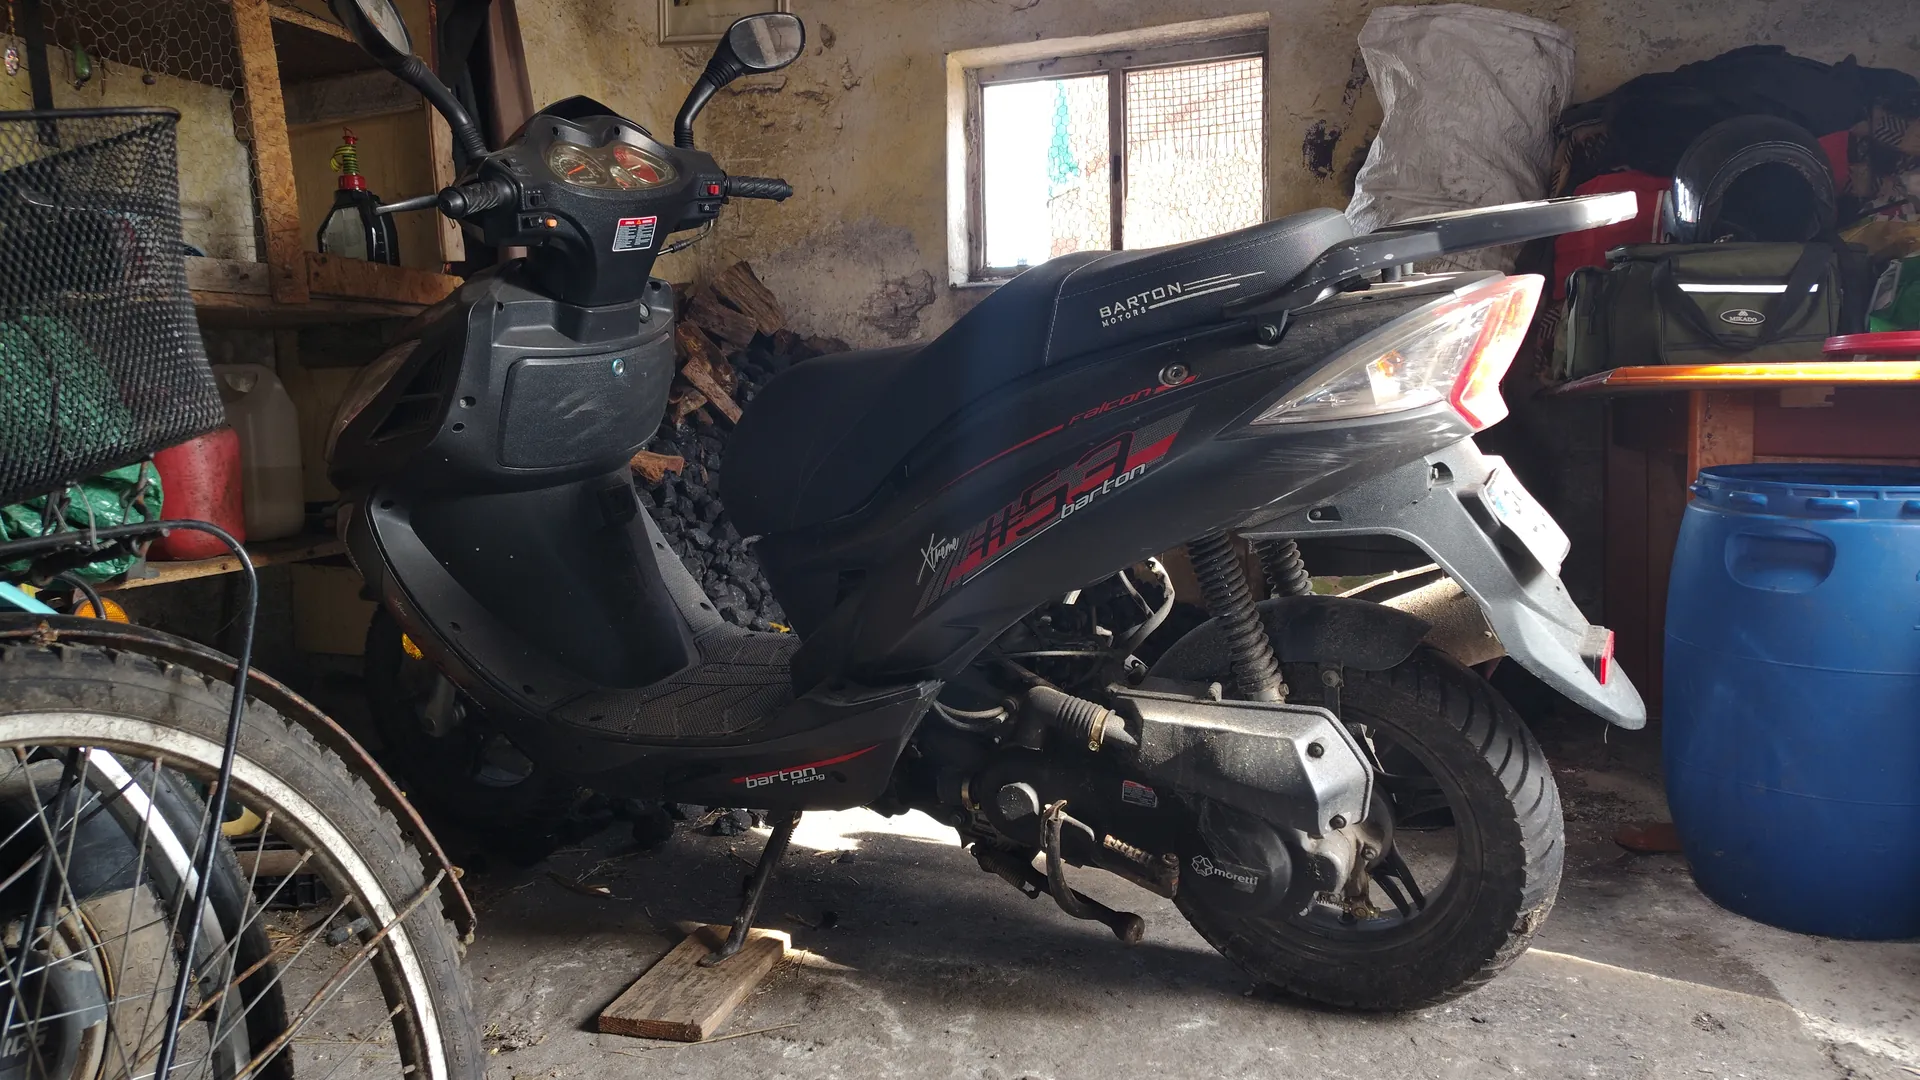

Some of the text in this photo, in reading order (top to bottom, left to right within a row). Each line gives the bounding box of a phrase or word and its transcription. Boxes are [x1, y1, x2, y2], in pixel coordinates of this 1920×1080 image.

[1099, 281, 1182, 318] BARTON
[1101, 306, 1146, 328] MOTORS
[1060, 463, 1146, 520] barton
[916, 533, 961, 586] Xtreme
[745, 767, 817, 789] barton
[791, 772, 826, 786] racing
[1214, 867, 1259, 886] moretti
